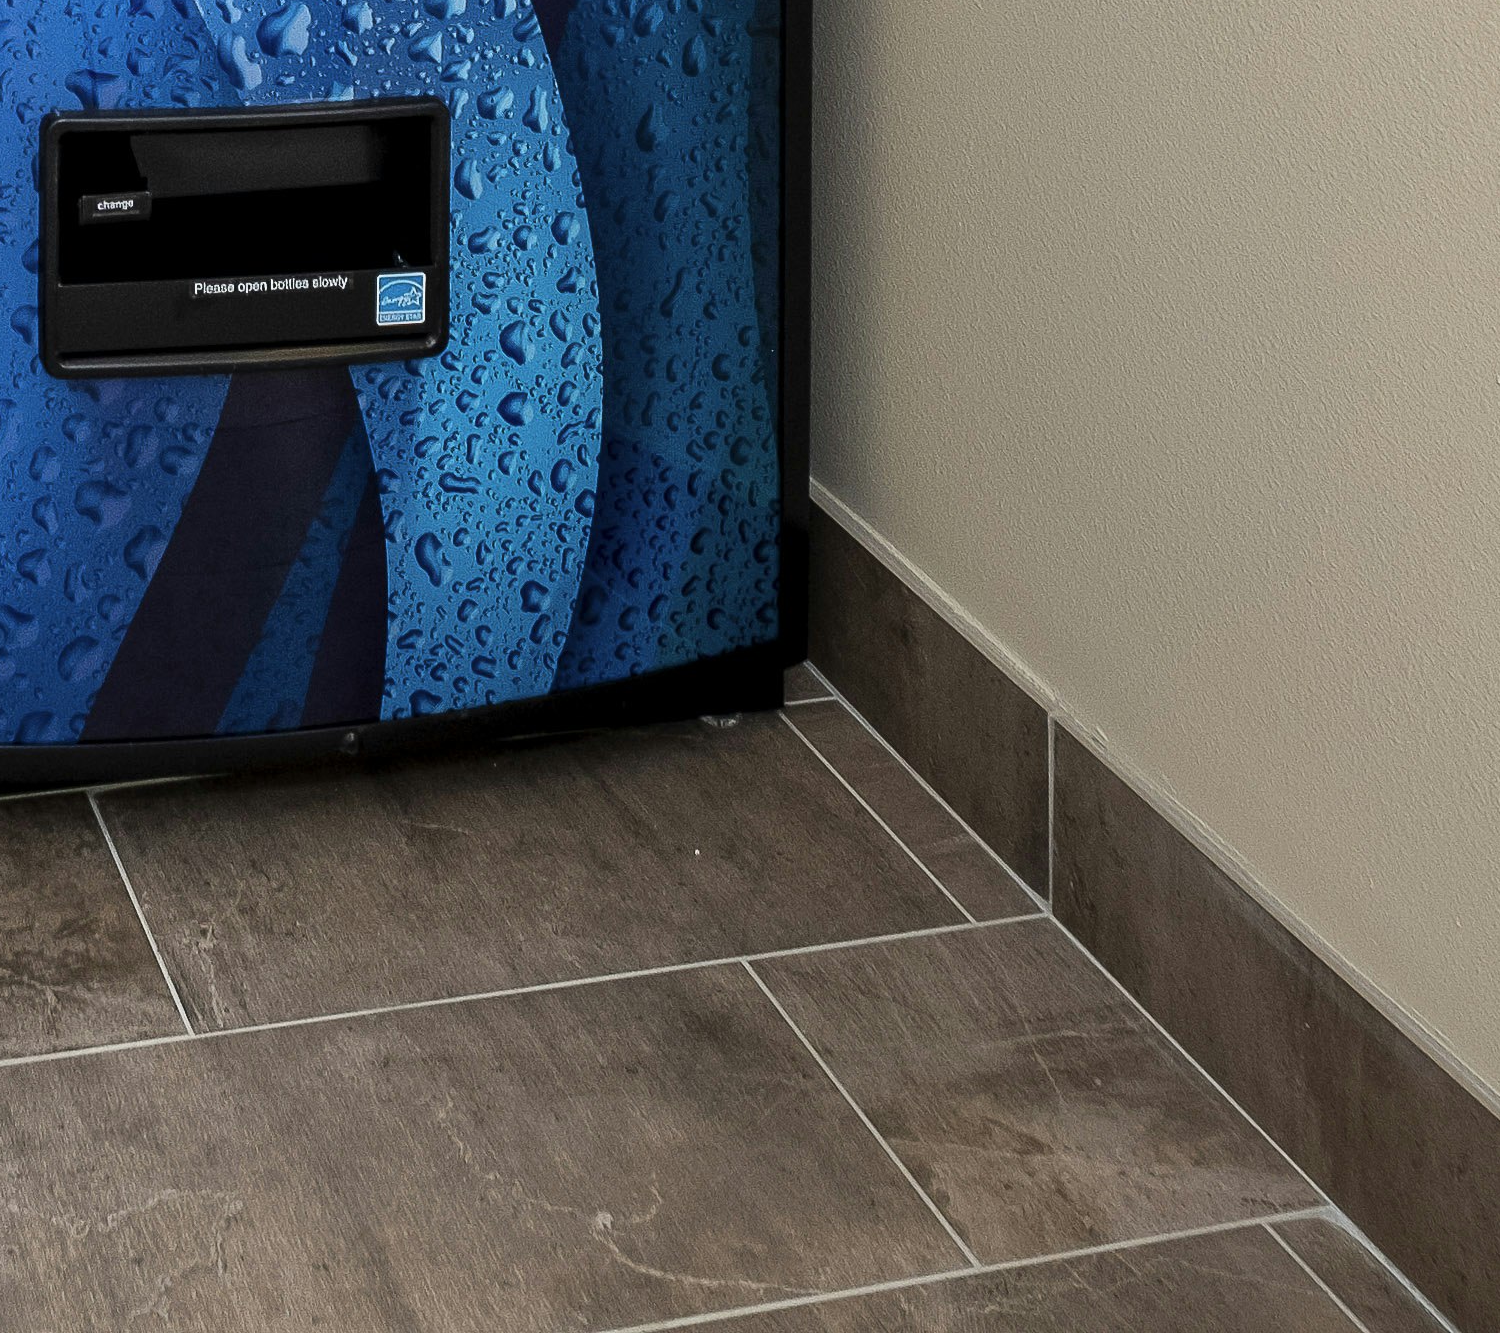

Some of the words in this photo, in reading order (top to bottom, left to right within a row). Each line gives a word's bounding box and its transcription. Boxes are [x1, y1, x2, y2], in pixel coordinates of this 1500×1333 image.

[97, 199, 134, 211] change
[194, 282, 235, 295] Please
[237, 281, 268, 294] open
[270, 278, 309, 291] bottles
[312, 275, 348, 290] slowly
